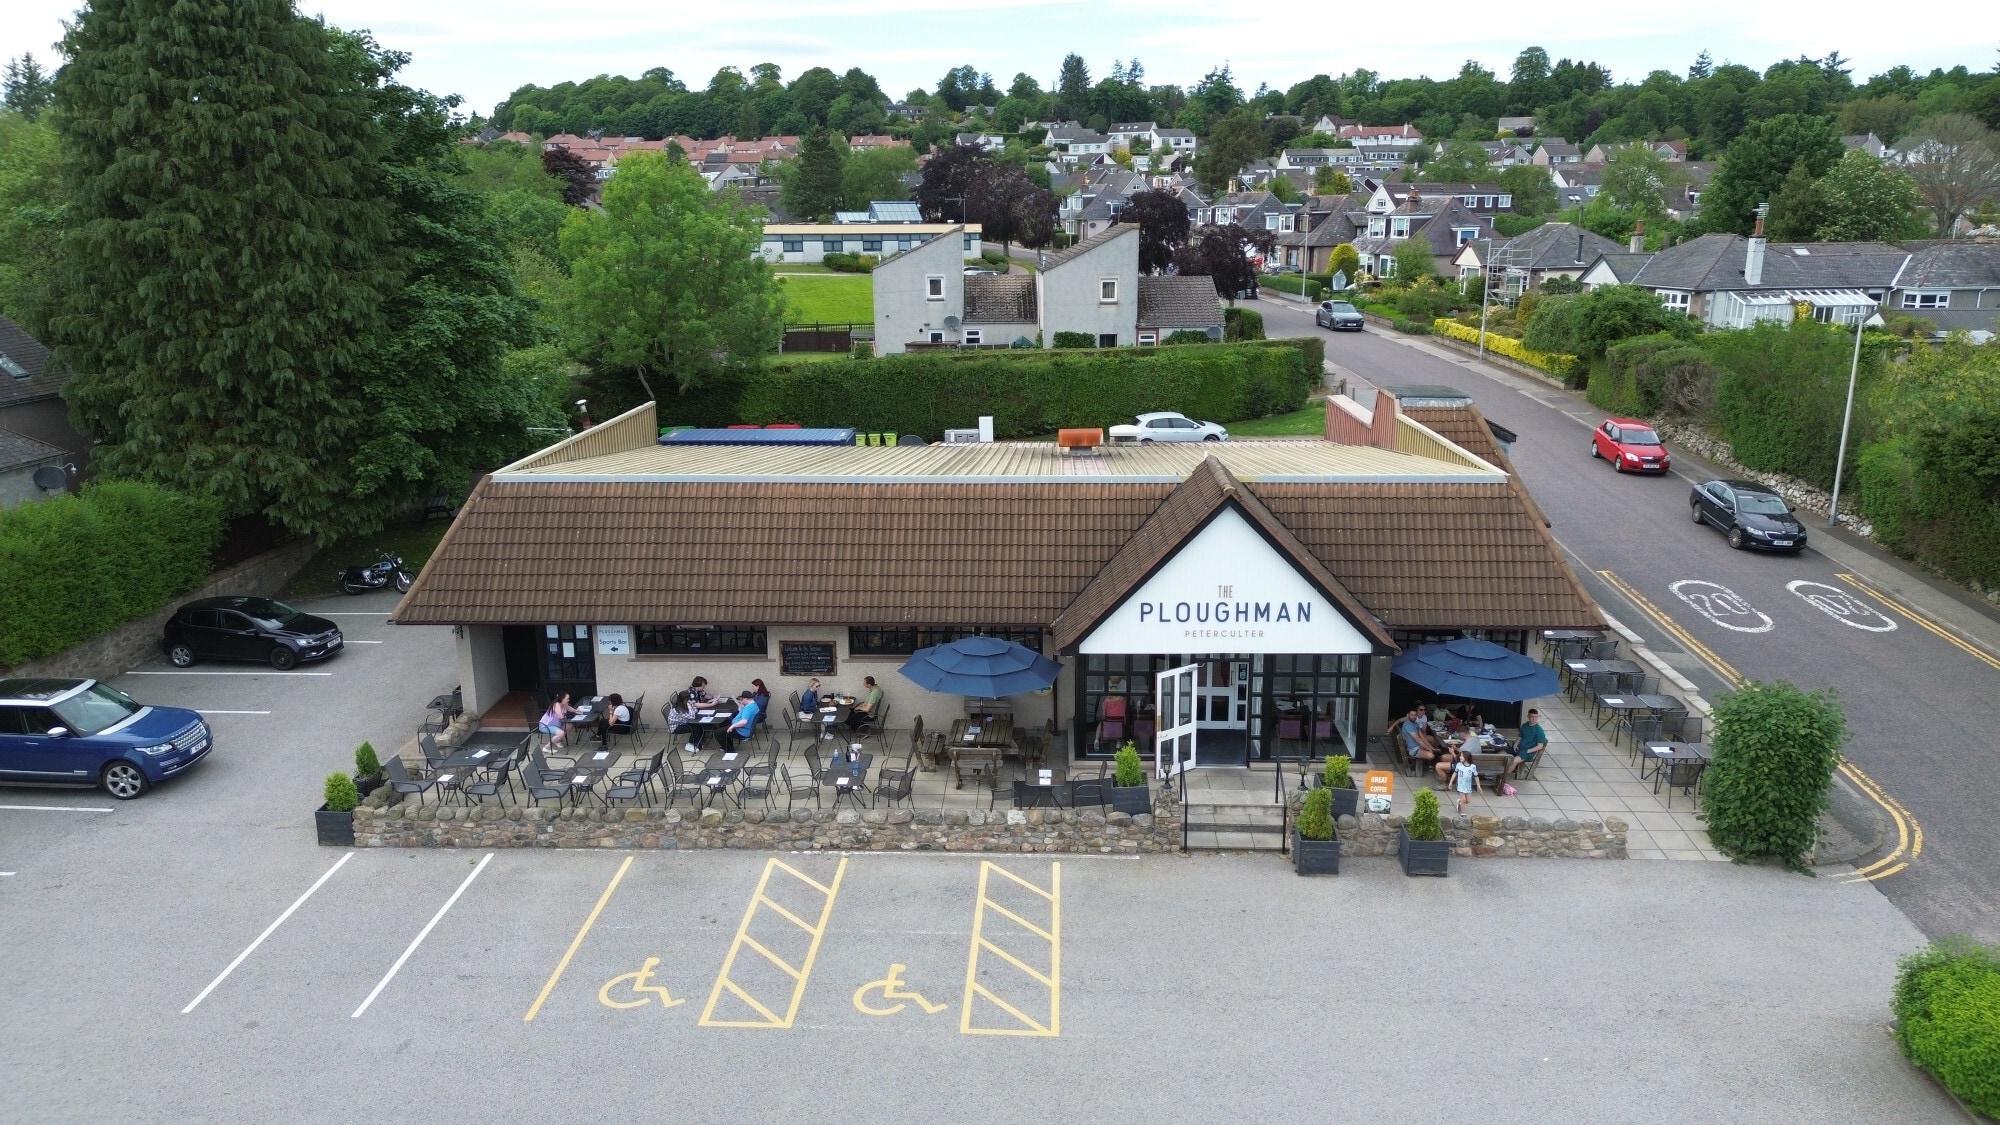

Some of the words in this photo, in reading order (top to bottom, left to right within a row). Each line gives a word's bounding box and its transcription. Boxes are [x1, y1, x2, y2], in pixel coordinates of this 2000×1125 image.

[1218, 585, 1233, 598] THE
[1140, 602, 1311, 622] PLOUGHMAN
[1689, 592, 1750, 616] 20
